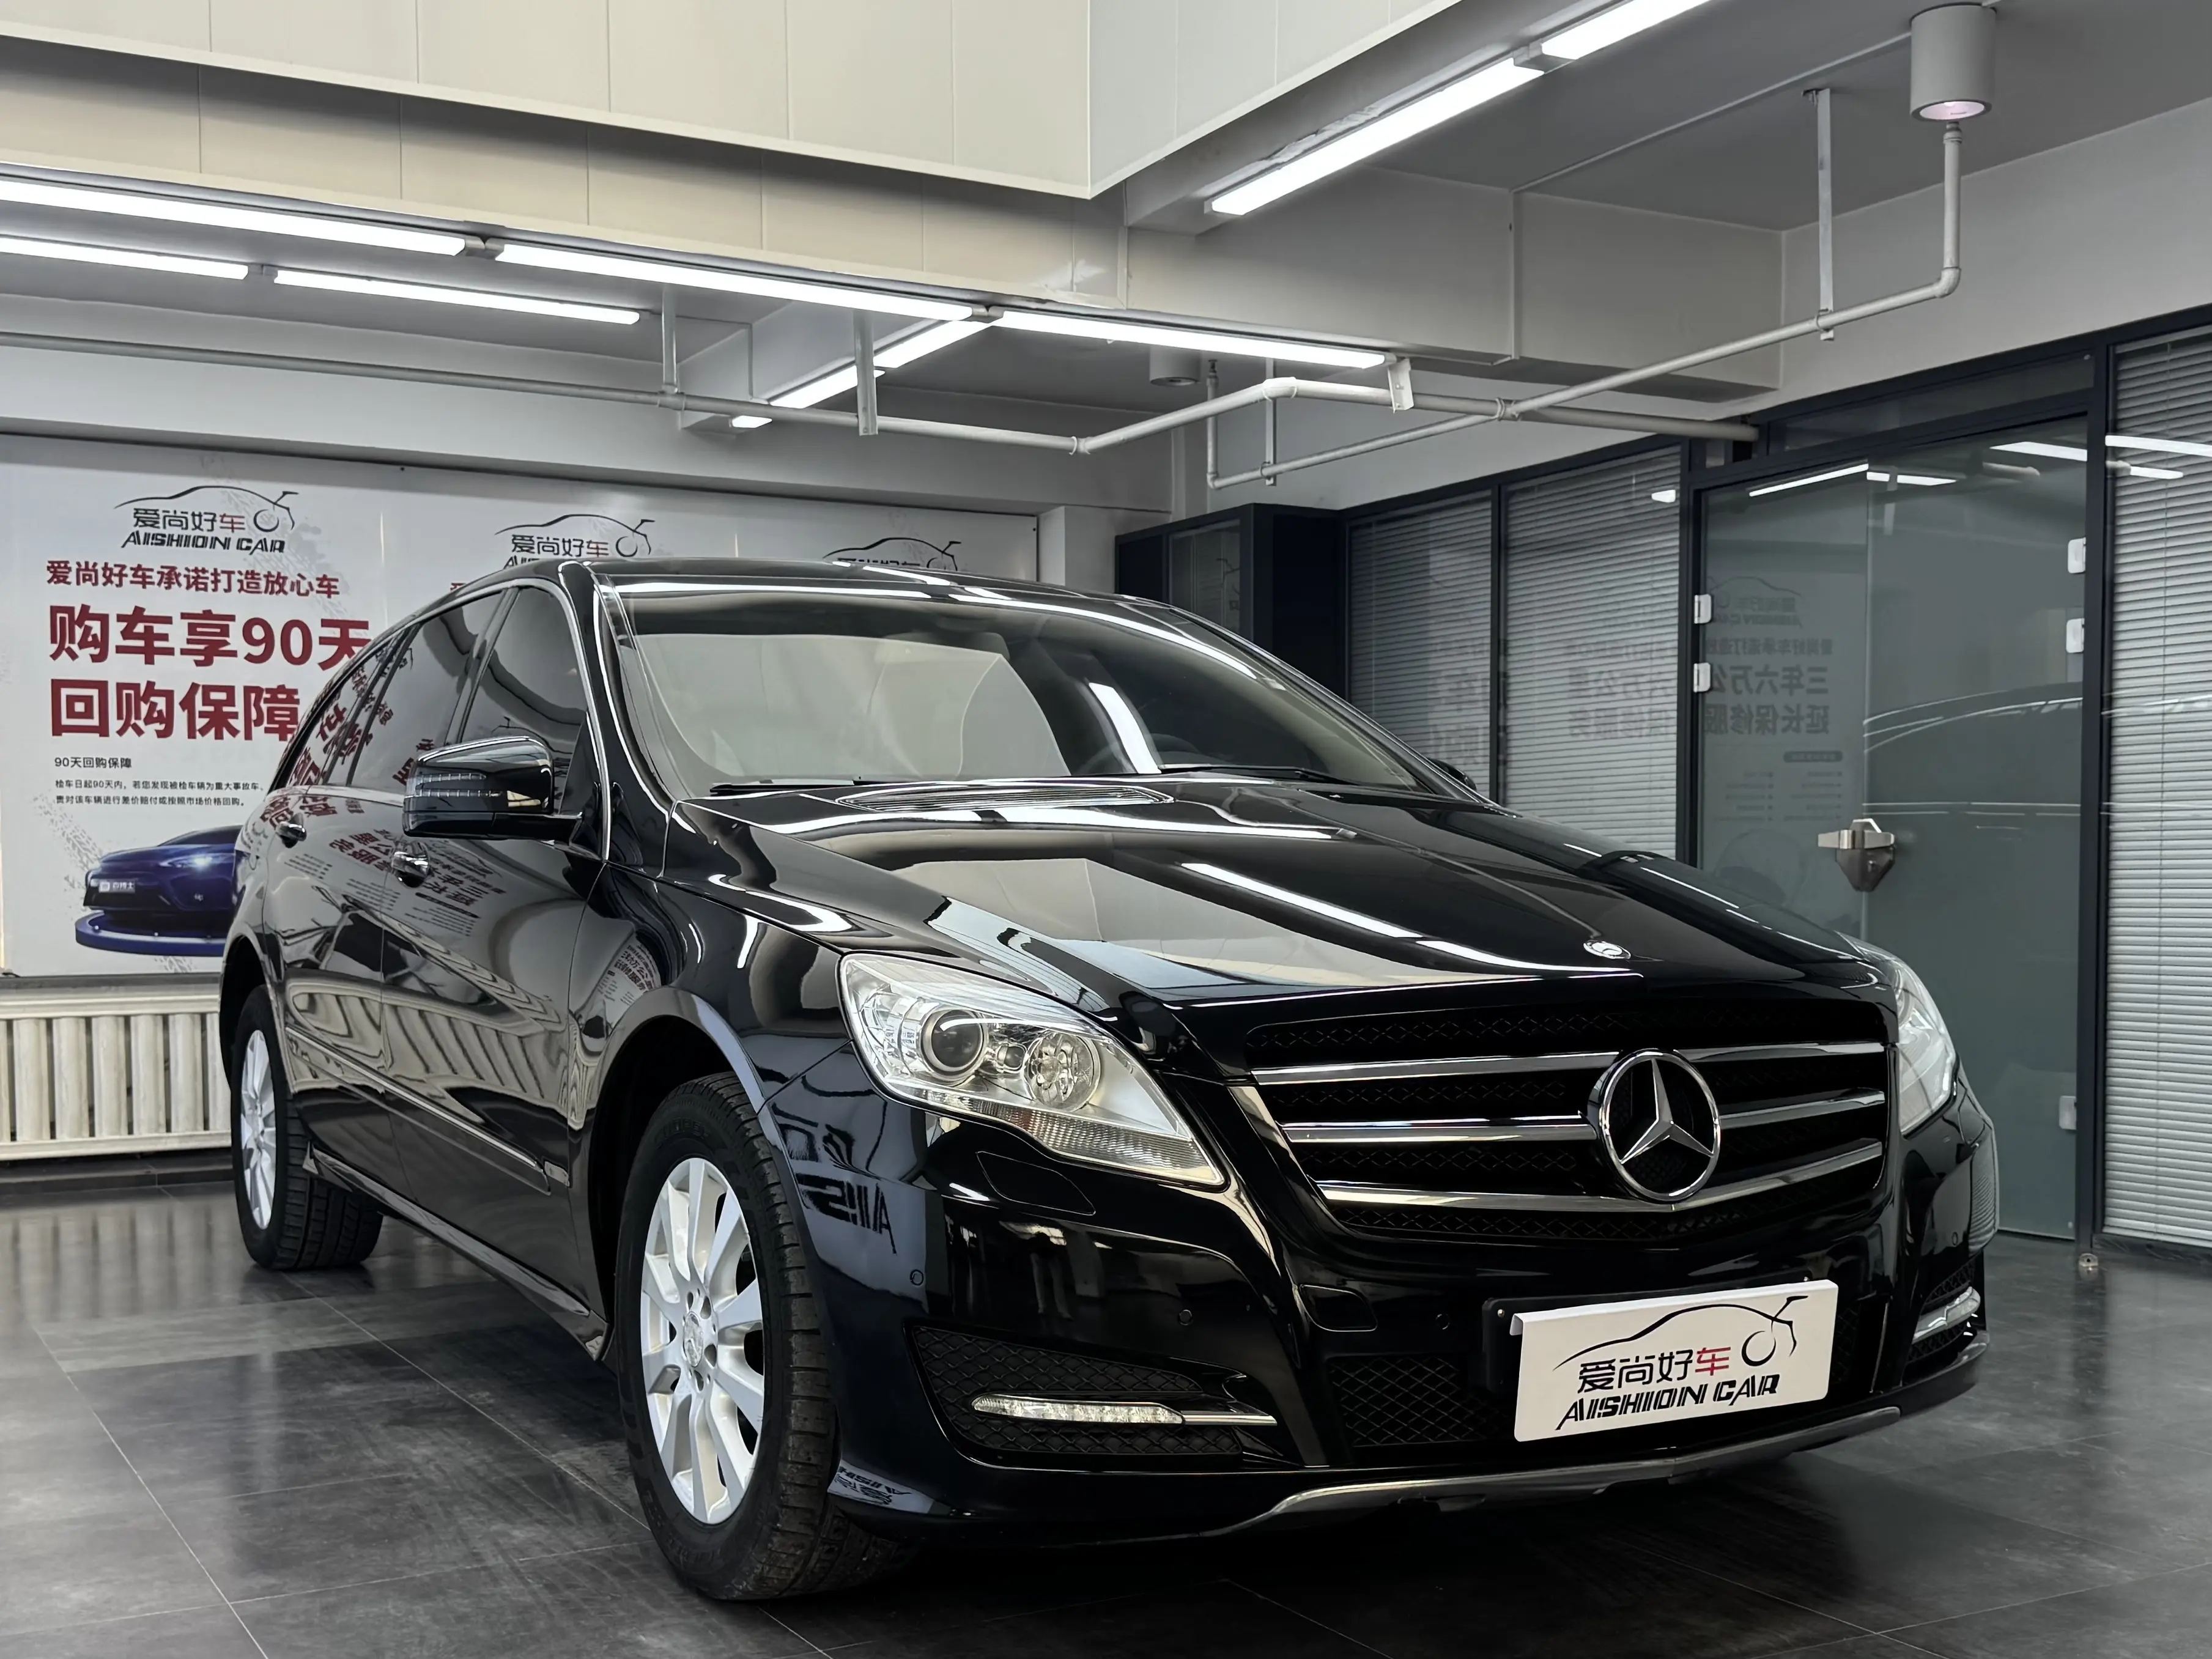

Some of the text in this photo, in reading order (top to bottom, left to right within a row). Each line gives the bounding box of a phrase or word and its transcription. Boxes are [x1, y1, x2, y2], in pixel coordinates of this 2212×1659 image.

[133, 508, 246, 533] 爱尚好车
[236, 538, 286, 555] CAR
[511, 534, 609, 558] 爱尚好车
[46, 560, 340, 598] 爱尚好车承诺打造放心车
[49, 604, 372, 671] 购车享90天
[51, 678, 300, 742] 回购保障
[54, 756, 132, 769] 90天回购保障
[1577, 1347, 1732, 1394] 爱尚好车
[1555, 1374, 1780, 1430] AISHION CAR
